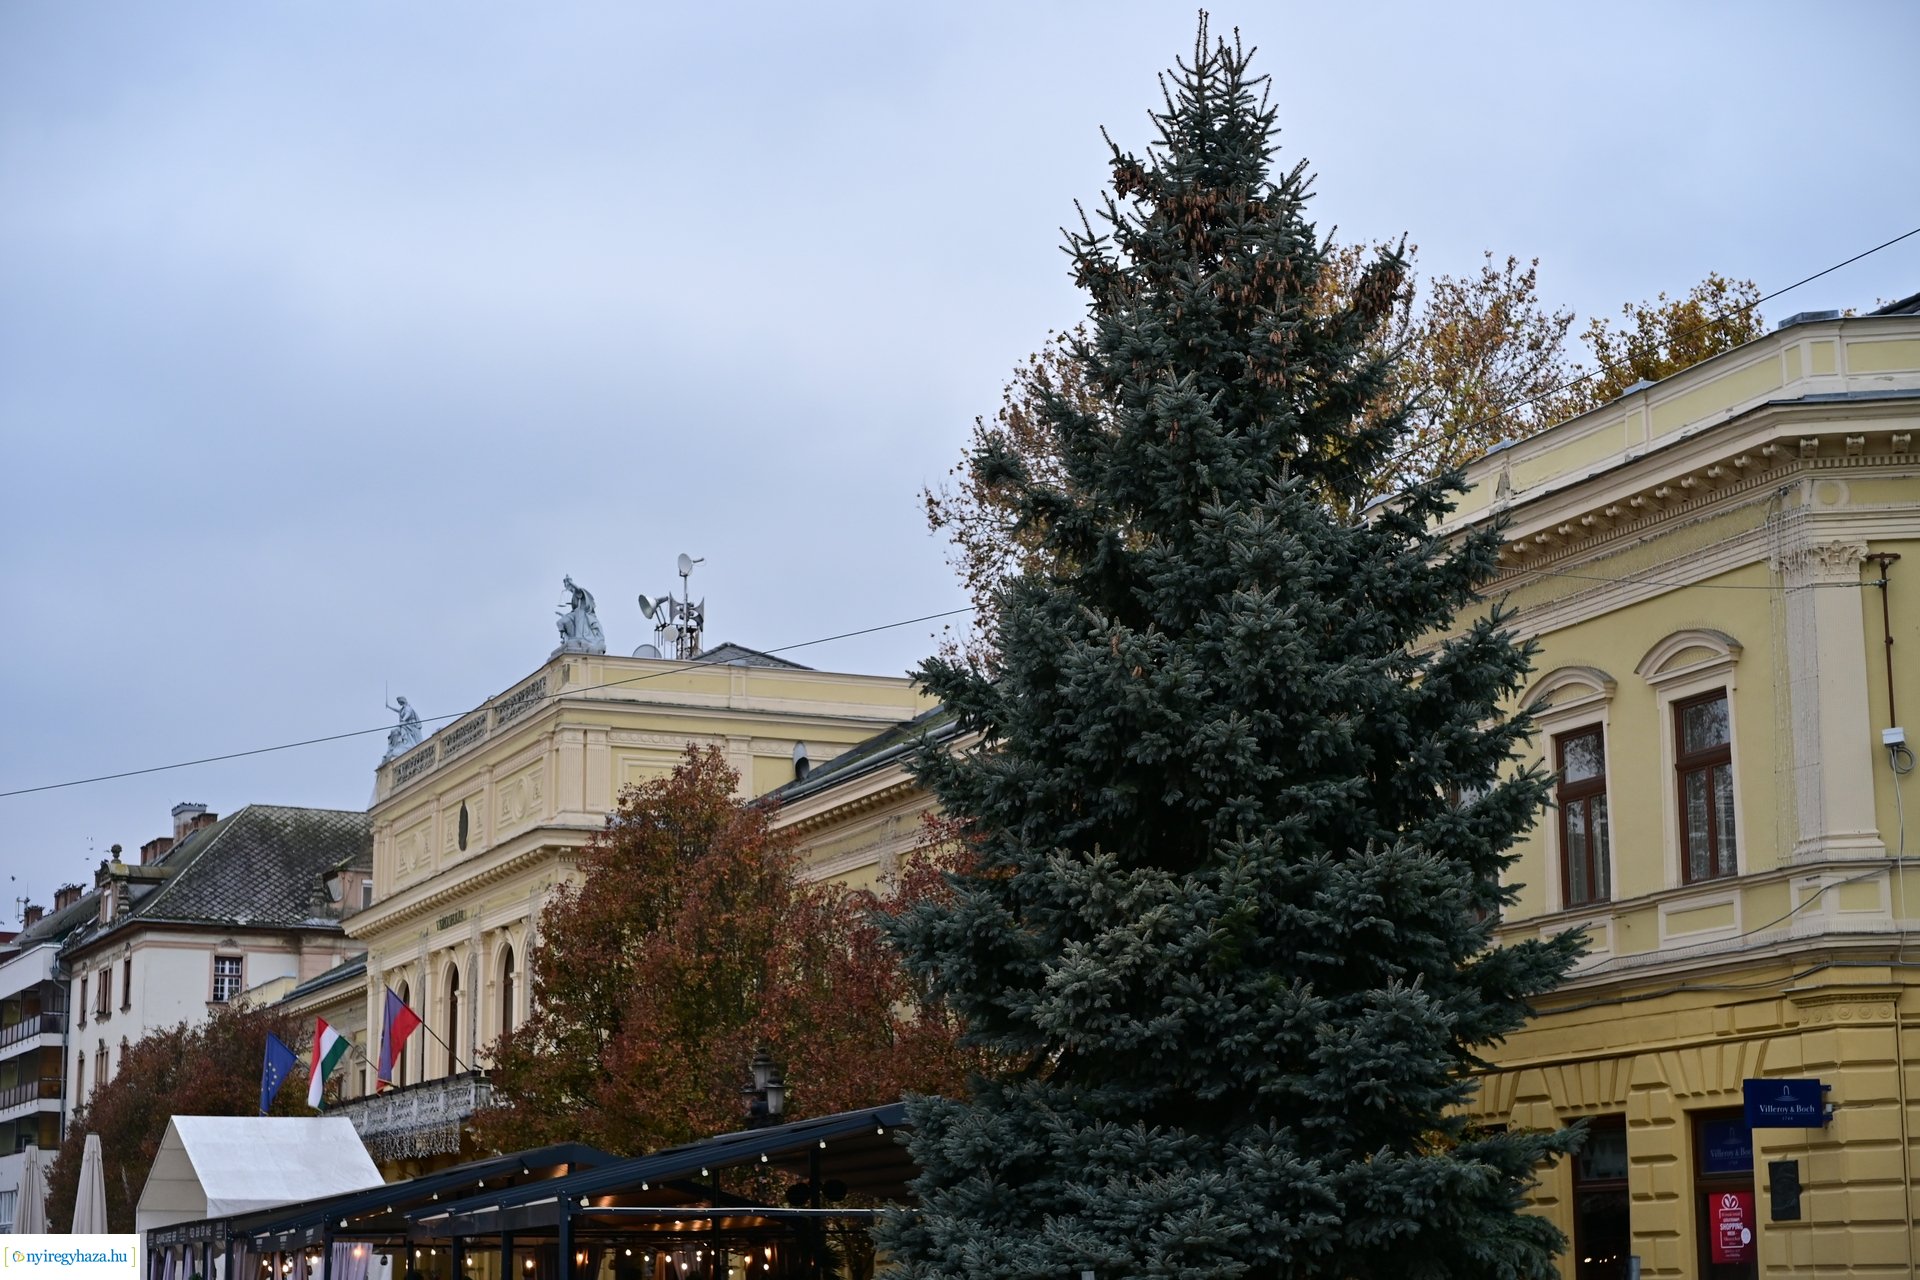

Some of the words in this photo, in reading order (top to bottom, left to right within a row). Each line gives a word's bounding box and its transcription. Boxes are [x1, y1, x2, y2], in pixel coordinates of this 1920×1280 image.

[1759, 1104, 1788, 1114] Villeroy
[1796, 1104, 1815, 1113] Boch
[1719, 1222, 1743, 1231] SHOPPING
